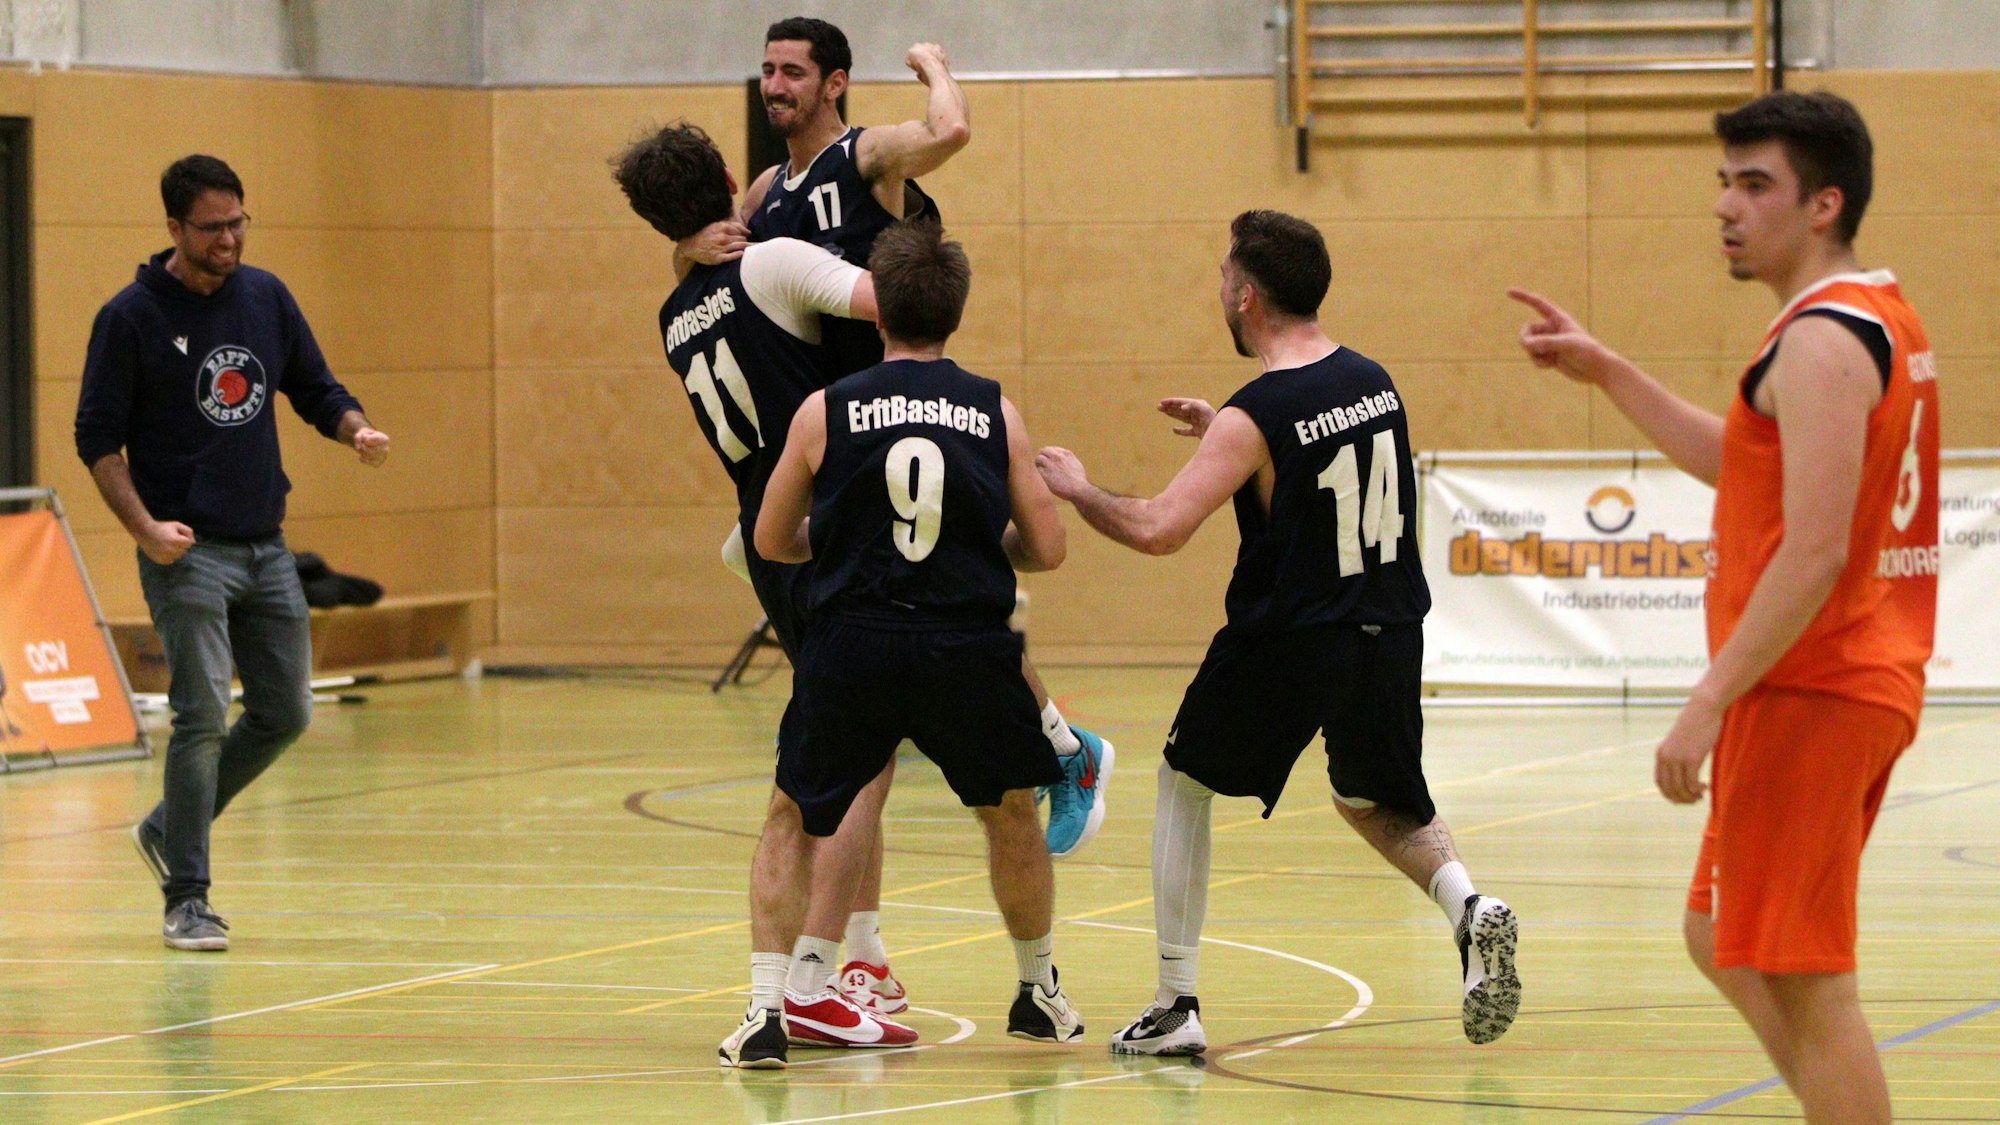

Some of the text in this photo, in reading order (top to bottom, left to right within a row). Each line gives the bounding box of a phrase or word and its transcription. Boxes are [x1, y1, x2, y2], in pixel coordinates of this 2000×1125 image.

[807, 181, 842, 231] 17
[200, 382, 264, 422] BASKETS
[684, 337, 766, 464] 11
[847, 395, 991, 440] ErftBaskets
[1294, 389, 1400, 446] ErftBaskets
[1890, 399, 1925, 533] 6
[885, 436, 945, 563] 9
[1317, 428, 1405, 578] 14
[1451, 507, 1547, 527] Autoteile
[1448, 530, 1711, 579] dederichs
[1943, 527, 2000, 549] Logis
[1543, 590, 1706, 611] Industriebedar
[848, 973, 866, 987] 43
